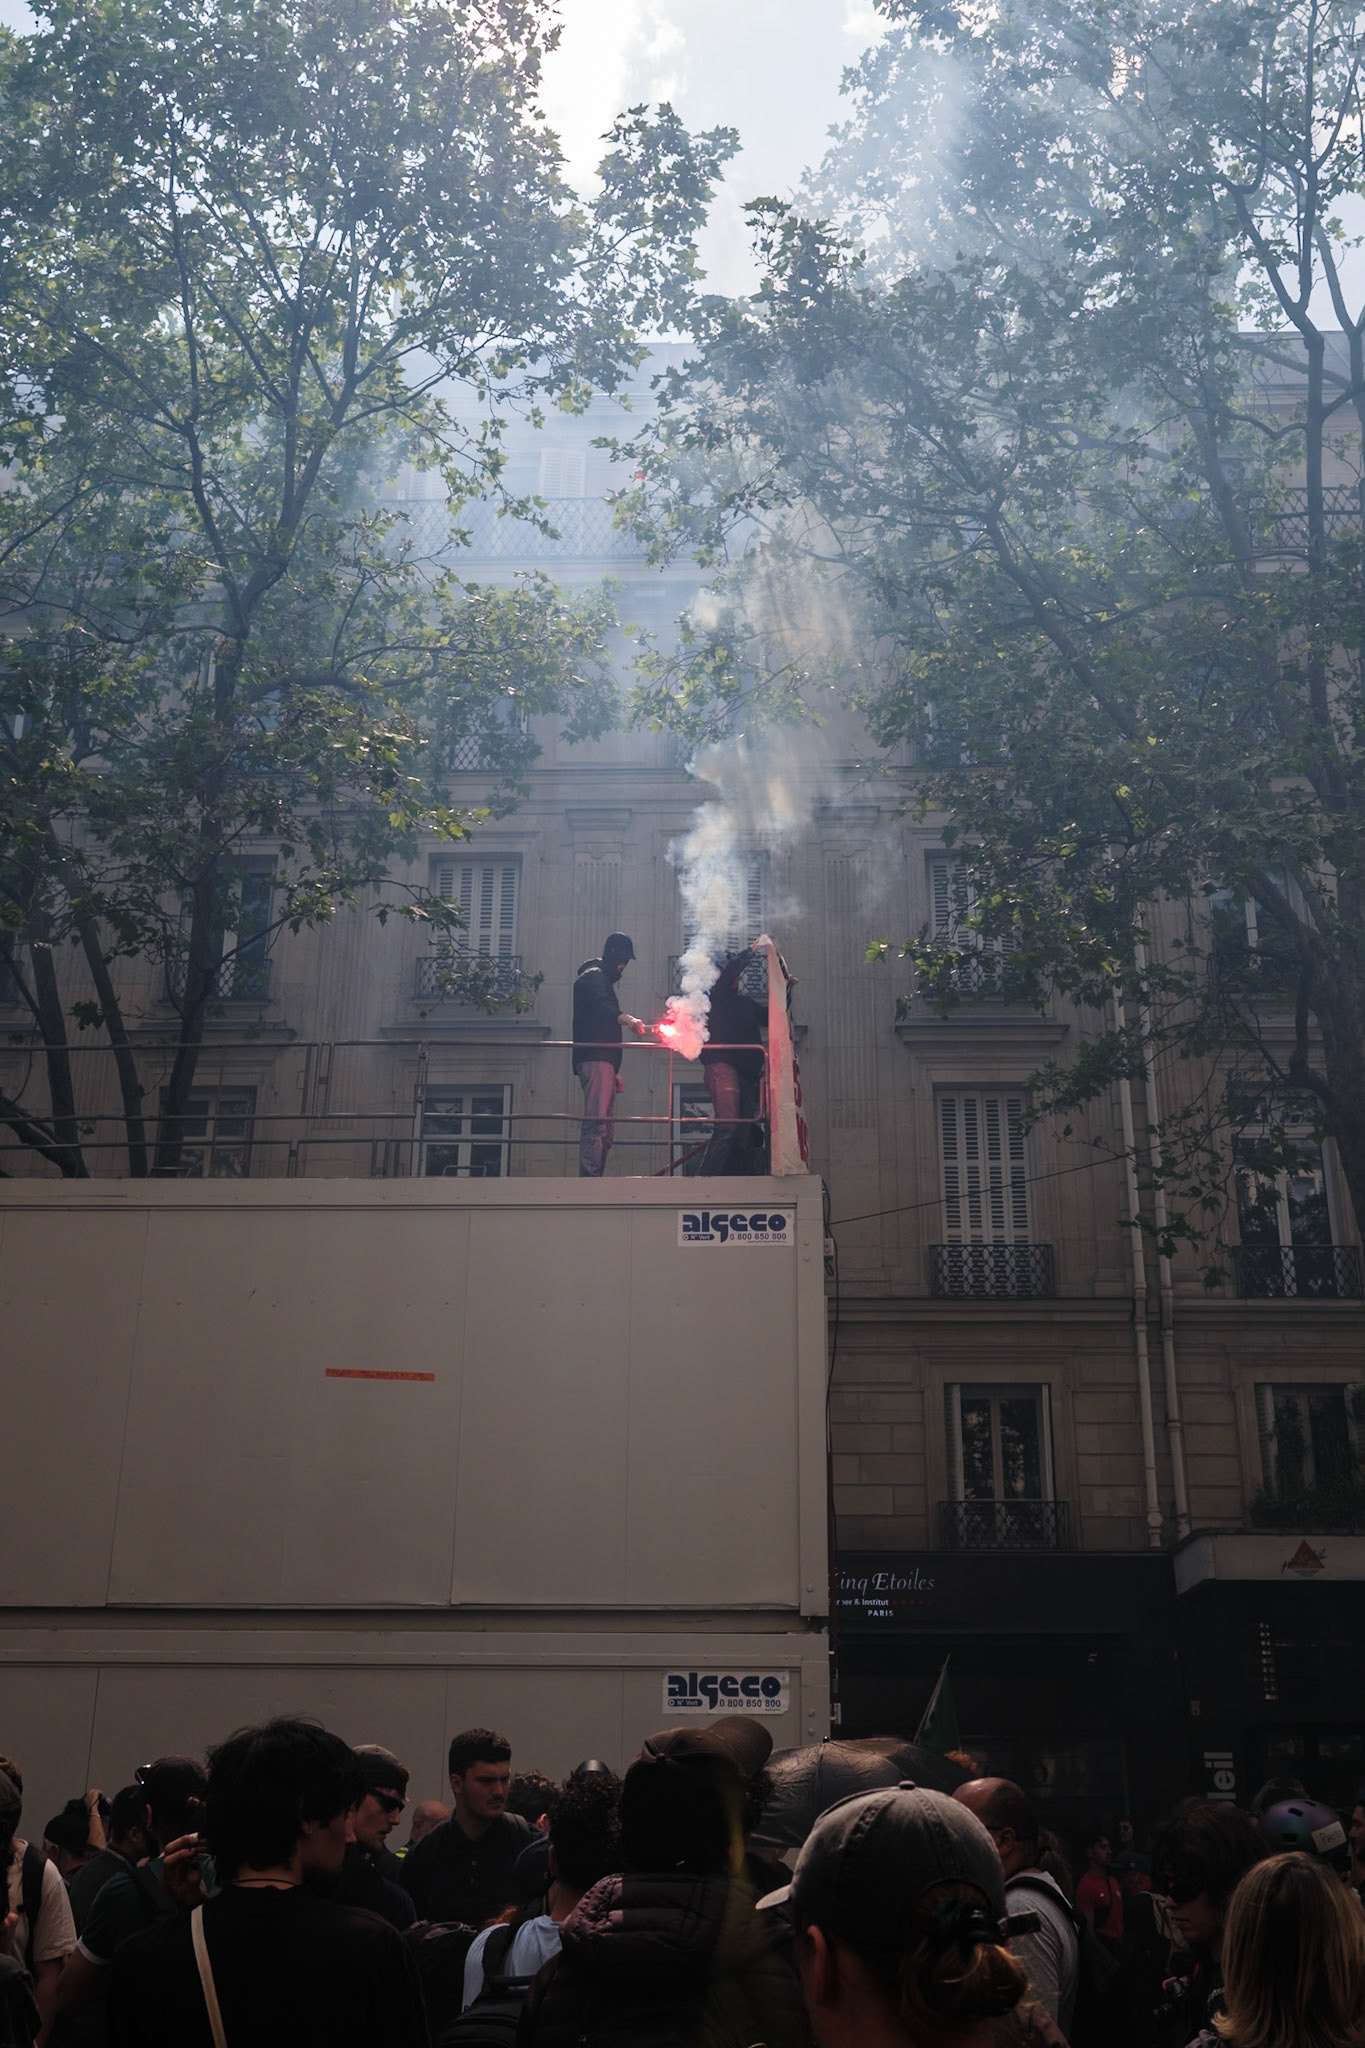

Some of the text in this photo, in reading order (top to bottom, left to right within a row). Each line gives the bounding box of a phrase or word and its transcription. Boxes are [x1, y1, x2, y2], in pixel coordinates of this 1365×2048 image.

[682, 1211, 787, 1243] algeco
[871, 1567, 936, 1591] Etoiles
[861, 1598, 889, 1606] Institut
[867, 1609, 894, 1617] PARIS
[667, 1672, 781, 1710] algeco
[719, 1699, 781, 1708] 0 800 850 800
